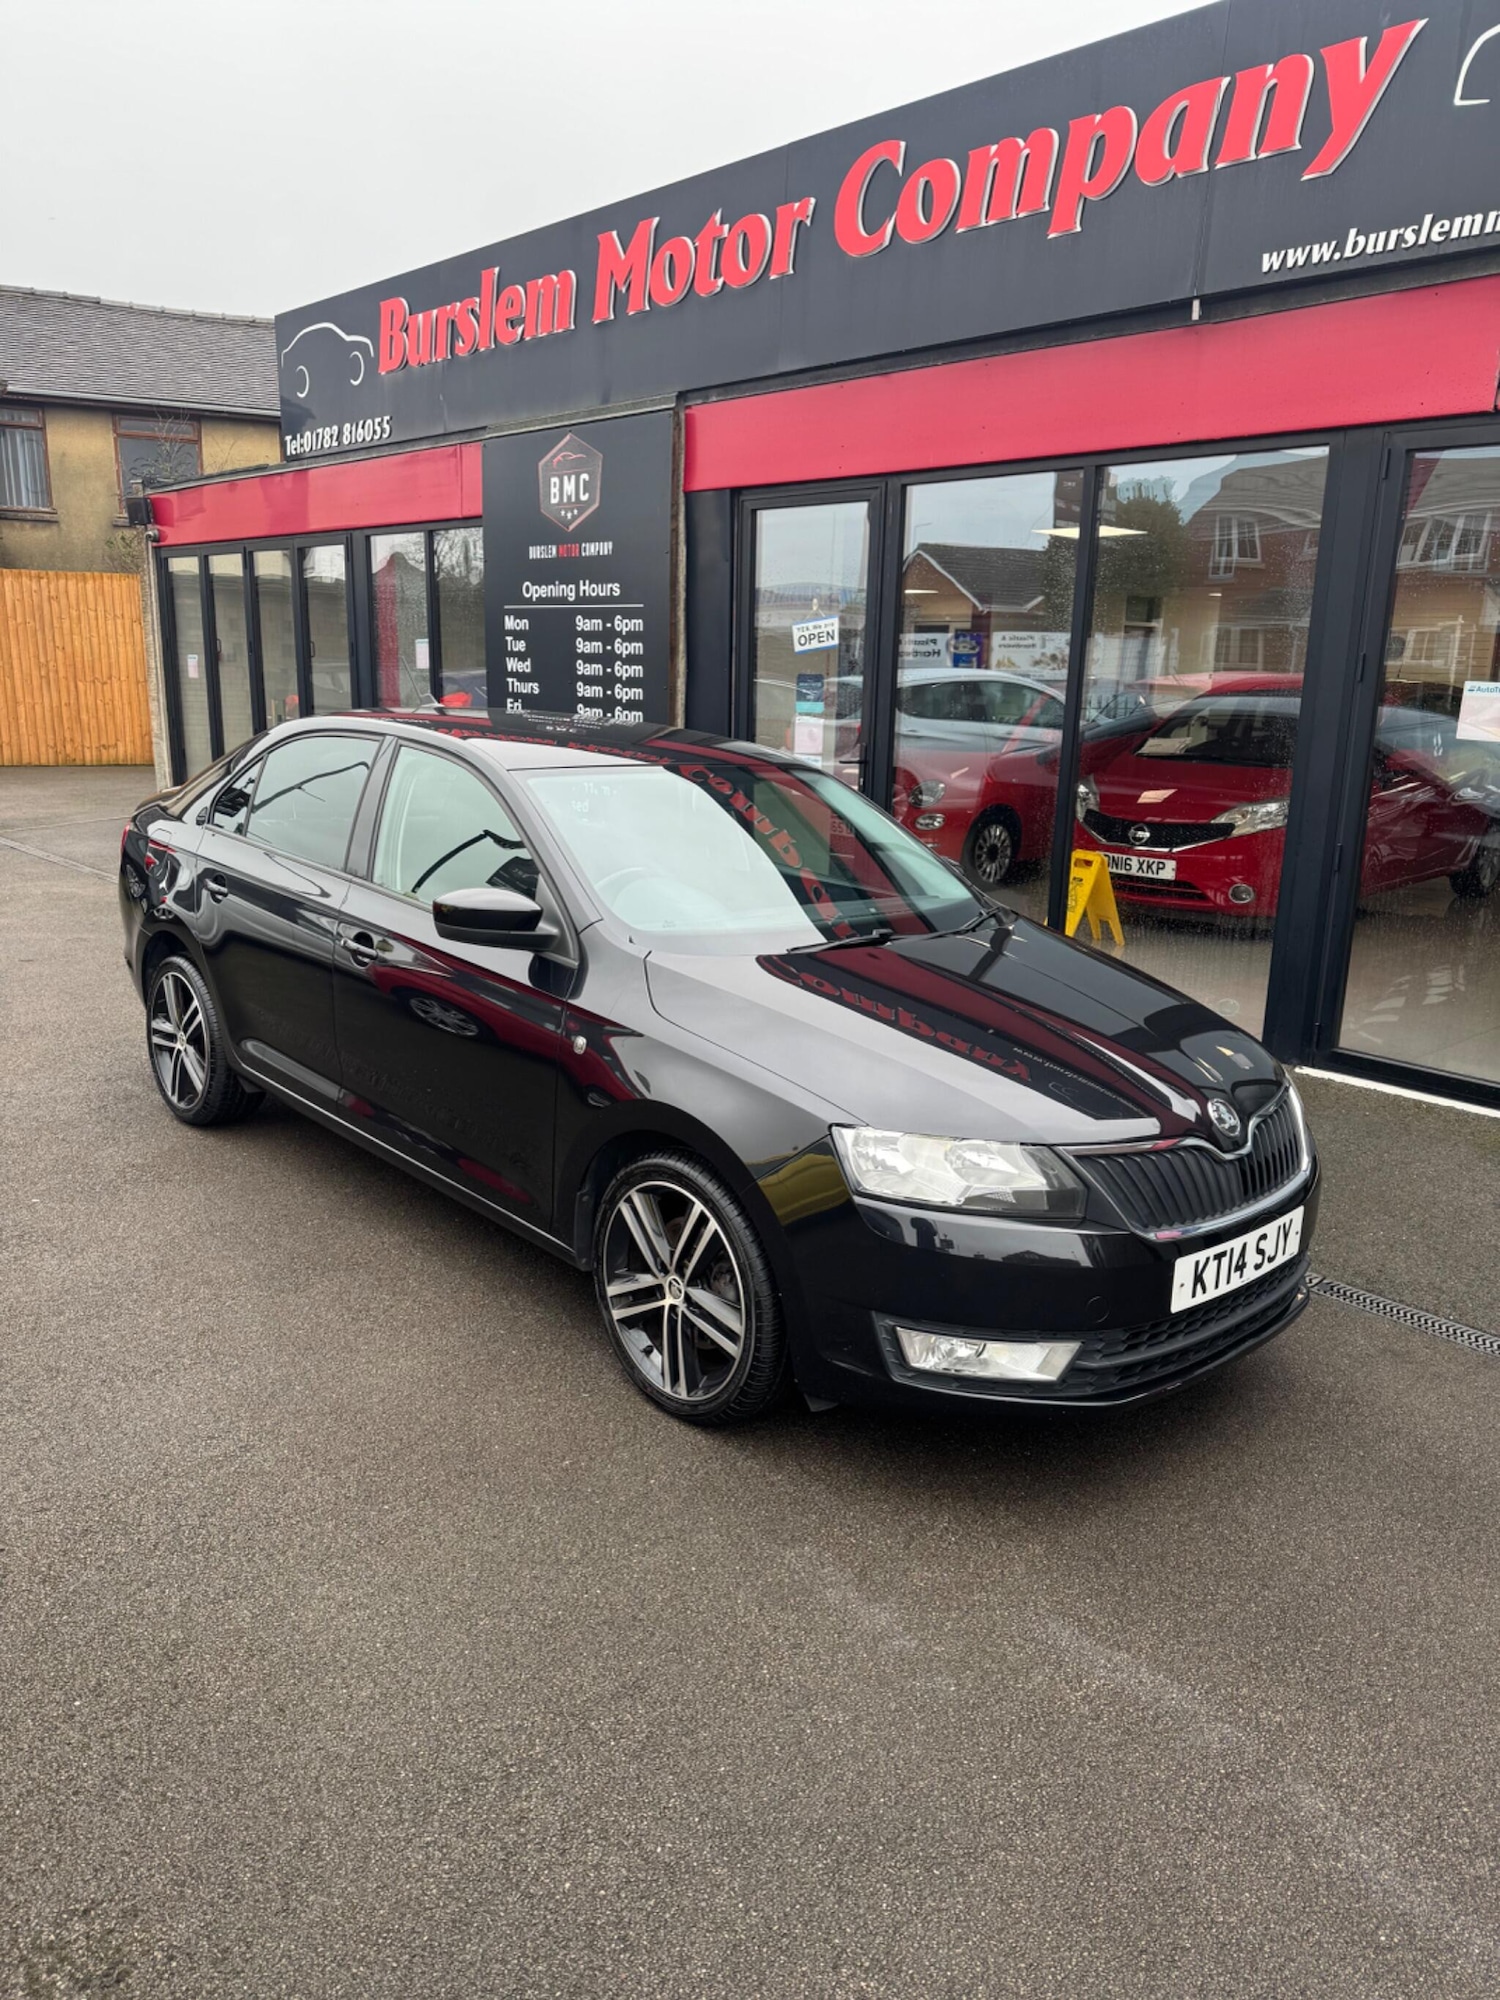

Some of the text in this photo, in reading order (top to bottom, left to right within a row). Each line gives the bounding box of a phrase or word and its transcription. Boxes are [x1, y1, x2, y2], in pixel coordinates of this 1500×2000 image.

[378, 18, 1428, 374] Burslem Motor Company
[343, 415, 391, 445] 816055
[550, 473, 590, 504] BMC
[581, 541, 613, 556] COMPANY
[522, 579, 621, 601] Opening Hours
[504, 615, 529, 630] Mon
[576, 615, 602, 631] 9am
[614, 615, 644, 635] 6pm
[505, 636, 526, 652] Tue
[576, 638, 602, 653] 9am
[614, 638, 644, 658] 6pm
[798, 630, 836, 647] OPEN
[506, 657, 531, 672] Wed
[576, 660, 602, 675] 9am
[614, 661, 644, 680] 6pm
[506, 678, 540, 694] Thurs
[576, 682, 602, 698] 9am
[614, 684, 644, 702] 6pm
[506, 698, 522, 711] Fri
[576, 704, 602, 717] 9am
[614, 706, 644, 722] 6pm
[1136, 859, 1166, 876] XKP
[1192, 1218, 1293, 1299] KT14 SJY
